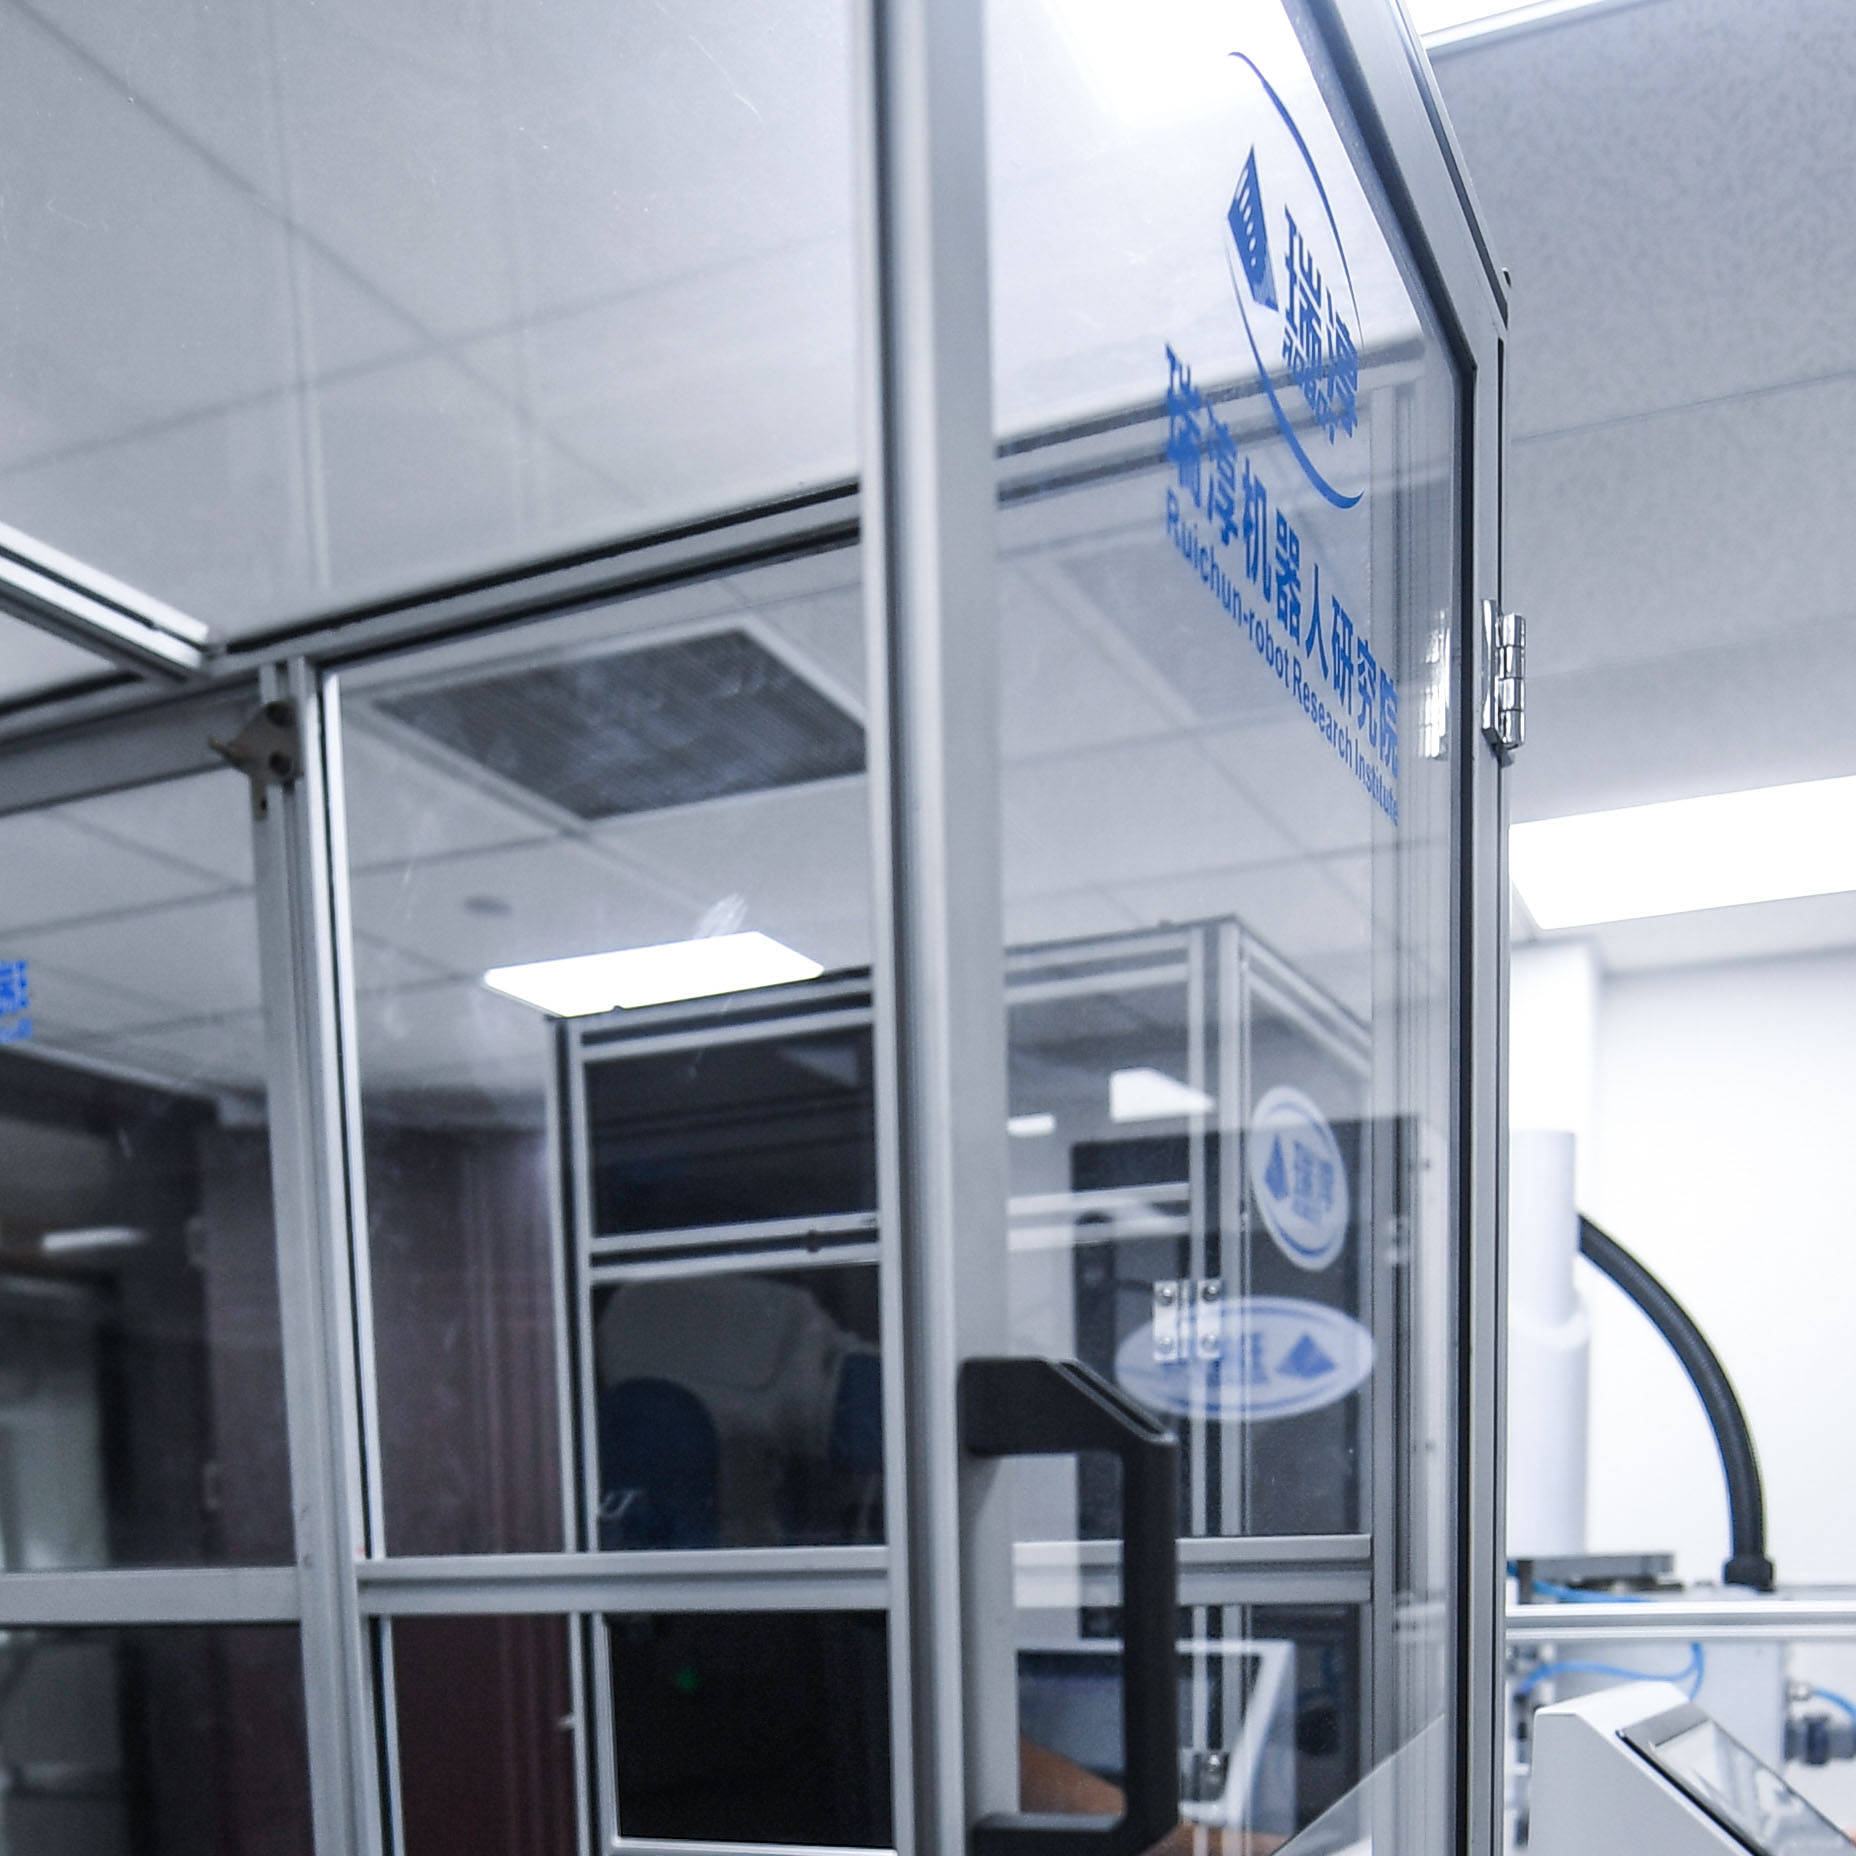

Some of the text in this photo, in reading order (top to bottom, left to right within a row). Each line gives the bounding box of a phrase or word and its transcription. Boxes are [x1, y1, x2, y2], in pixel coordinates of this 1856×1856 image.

[1165, 342, 1399, 778] 瑞淳机器人研究院
[1166, 488, 1399, 827] Ruichun-robot Research Institute
